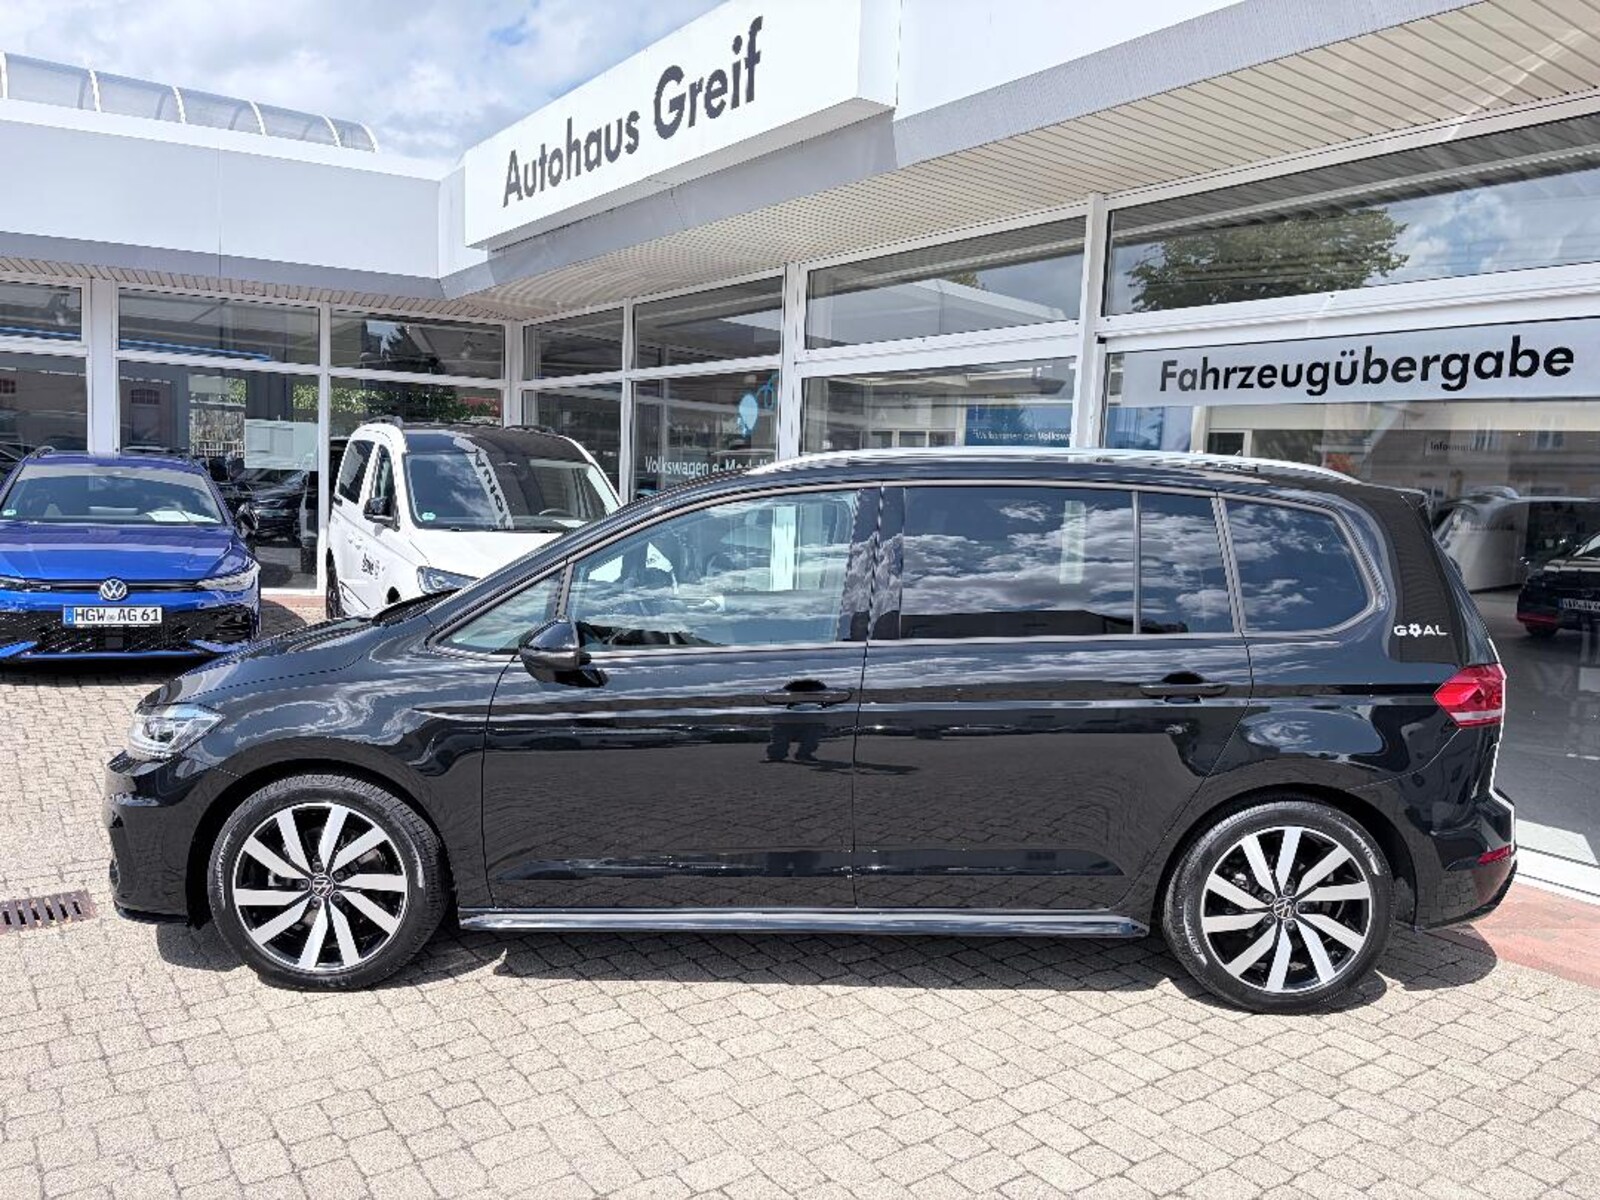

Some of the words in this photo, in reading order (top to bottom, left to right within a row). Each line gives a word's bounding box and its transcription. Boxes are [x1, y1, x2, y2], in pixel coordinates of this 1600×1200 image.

[503, 110, 641, 208] Autohaus
[653, 15, 764, 140] Greif
[1159, 335, 1575, 397] Fahrzeugübergabe
[645, 455, 709, 480] Volkswagen
[75, 608, 106, 622] HGW
[117, 608, 137, 622] AG
[141, 608, 160, 622] 61
